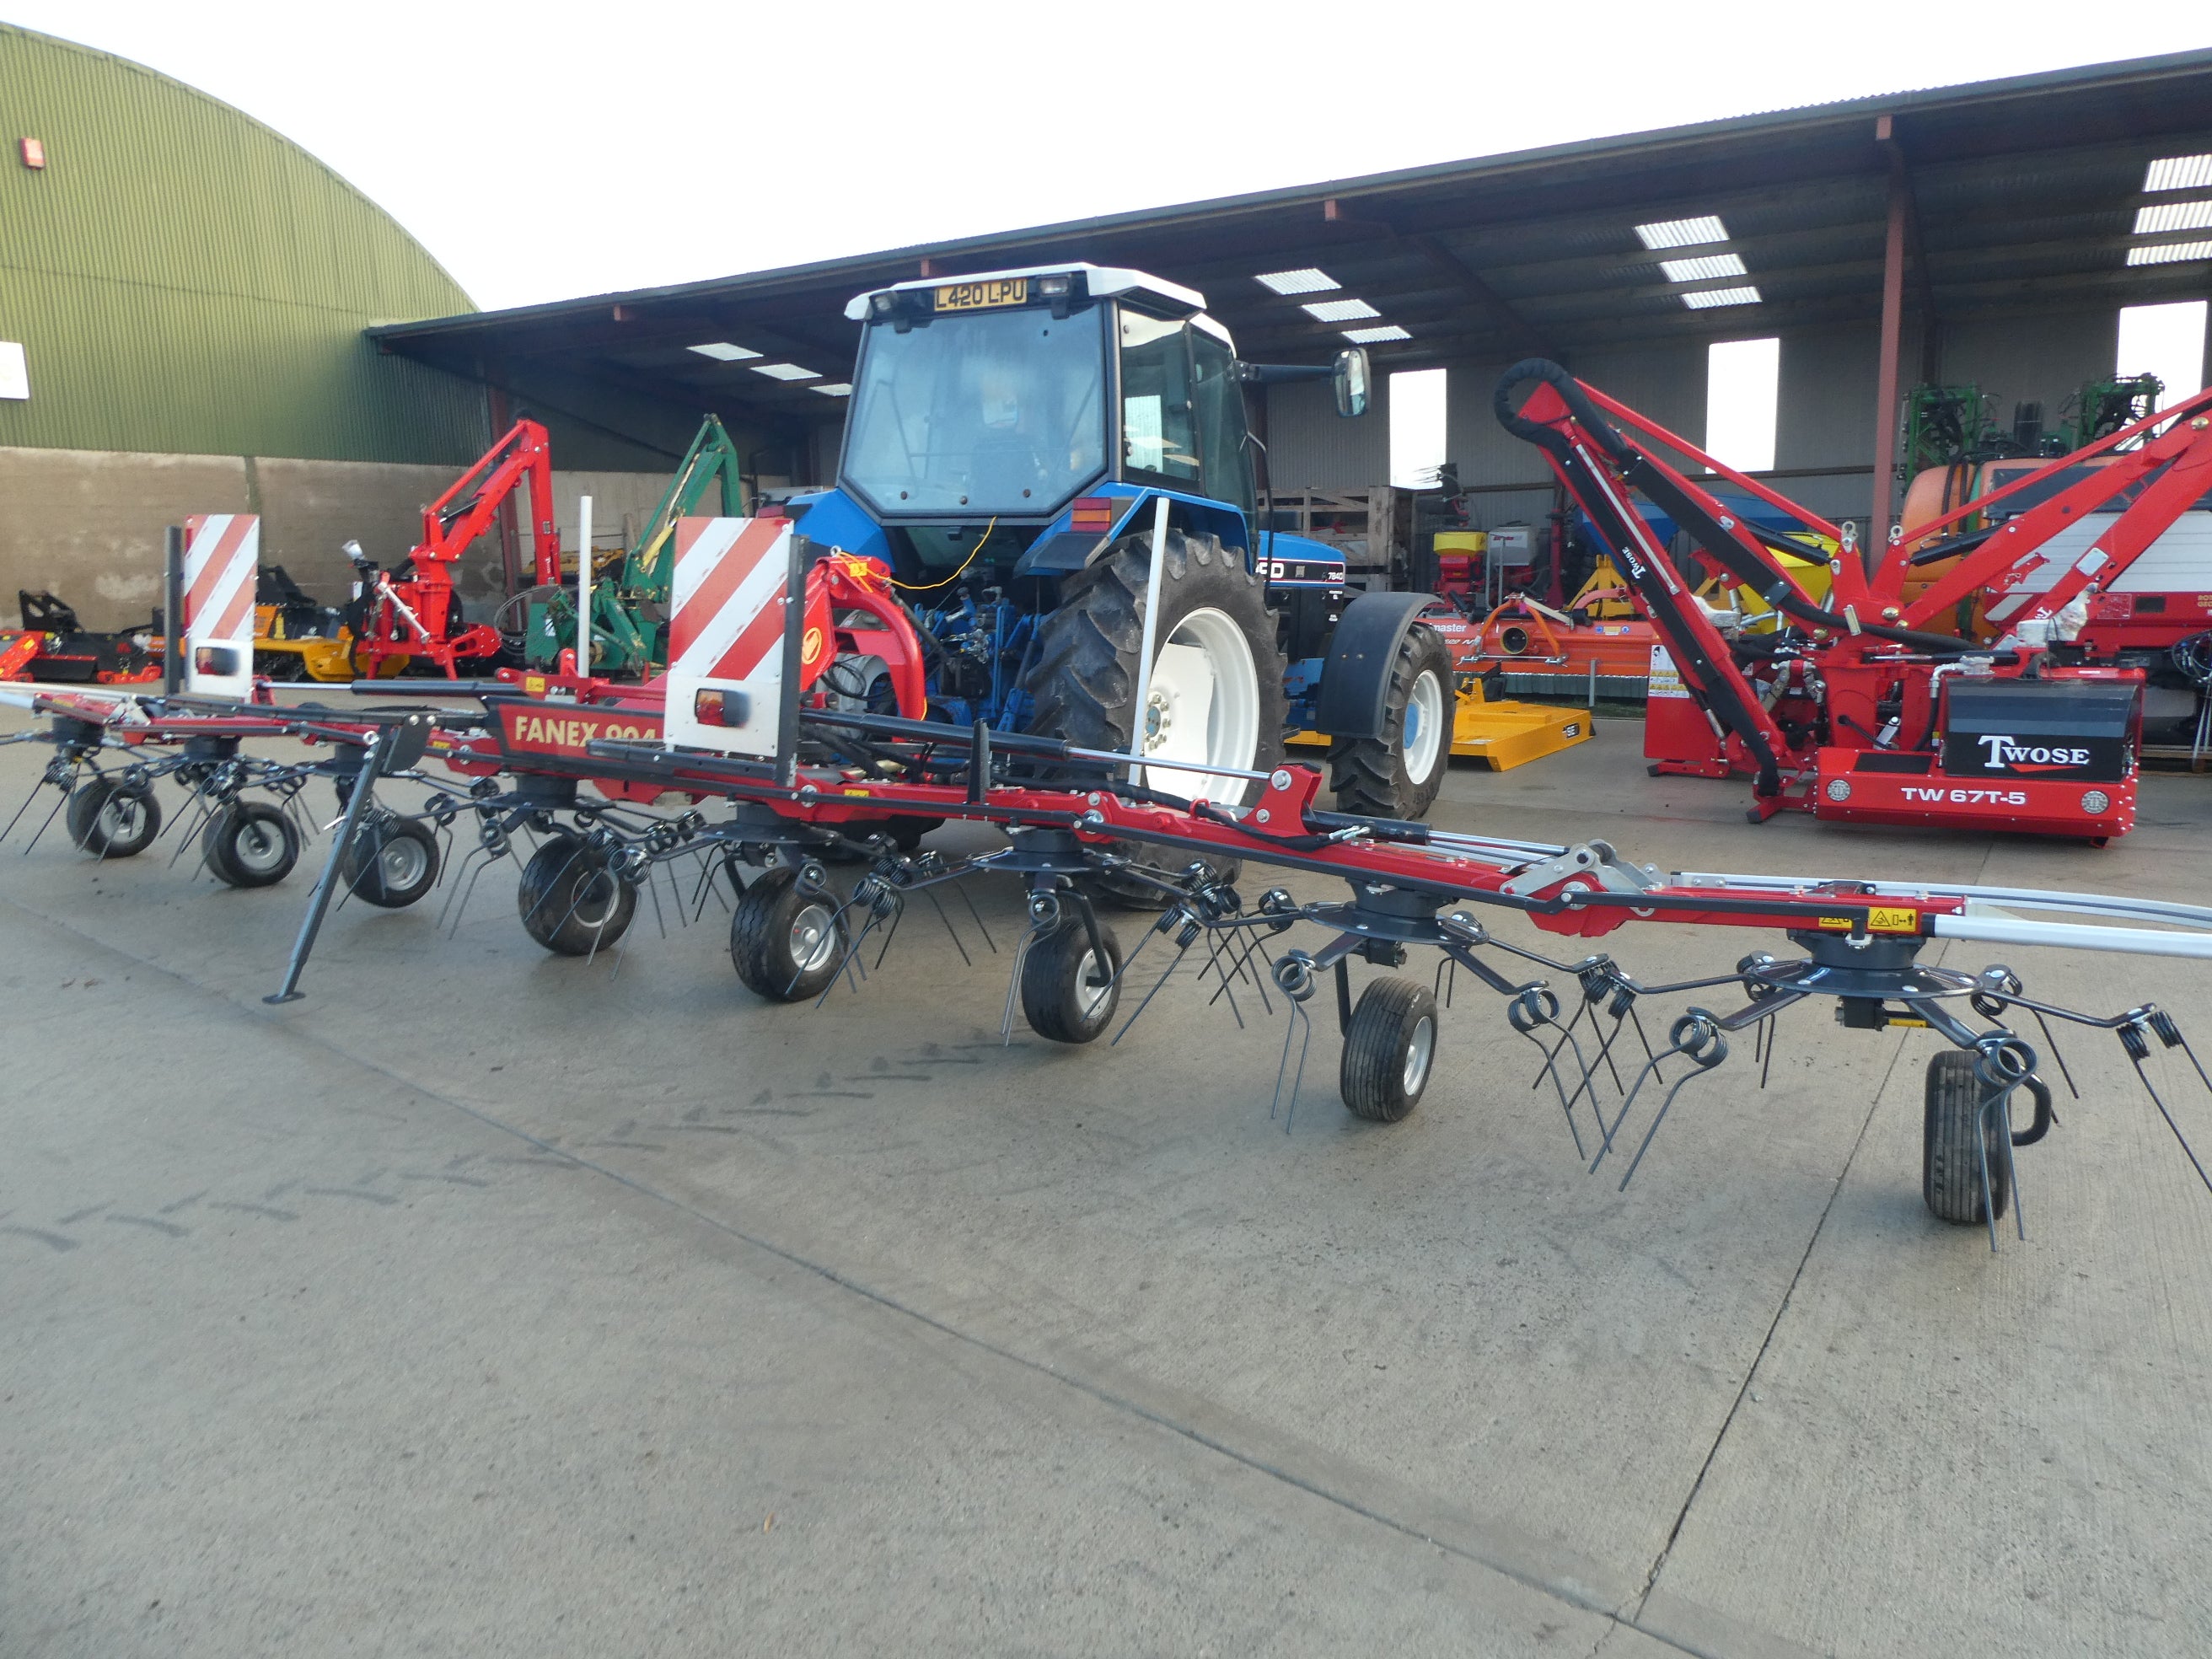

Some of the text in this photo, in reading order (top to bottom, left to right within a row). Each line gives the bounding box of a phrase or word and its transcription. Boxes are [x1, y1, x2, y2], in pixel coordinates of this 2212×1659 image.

[936, 281, 1024, 309] L420 LPU
[515, 716, 599, 748] FANEX
[1900, 787, 2027, 805] TW 67T-5
